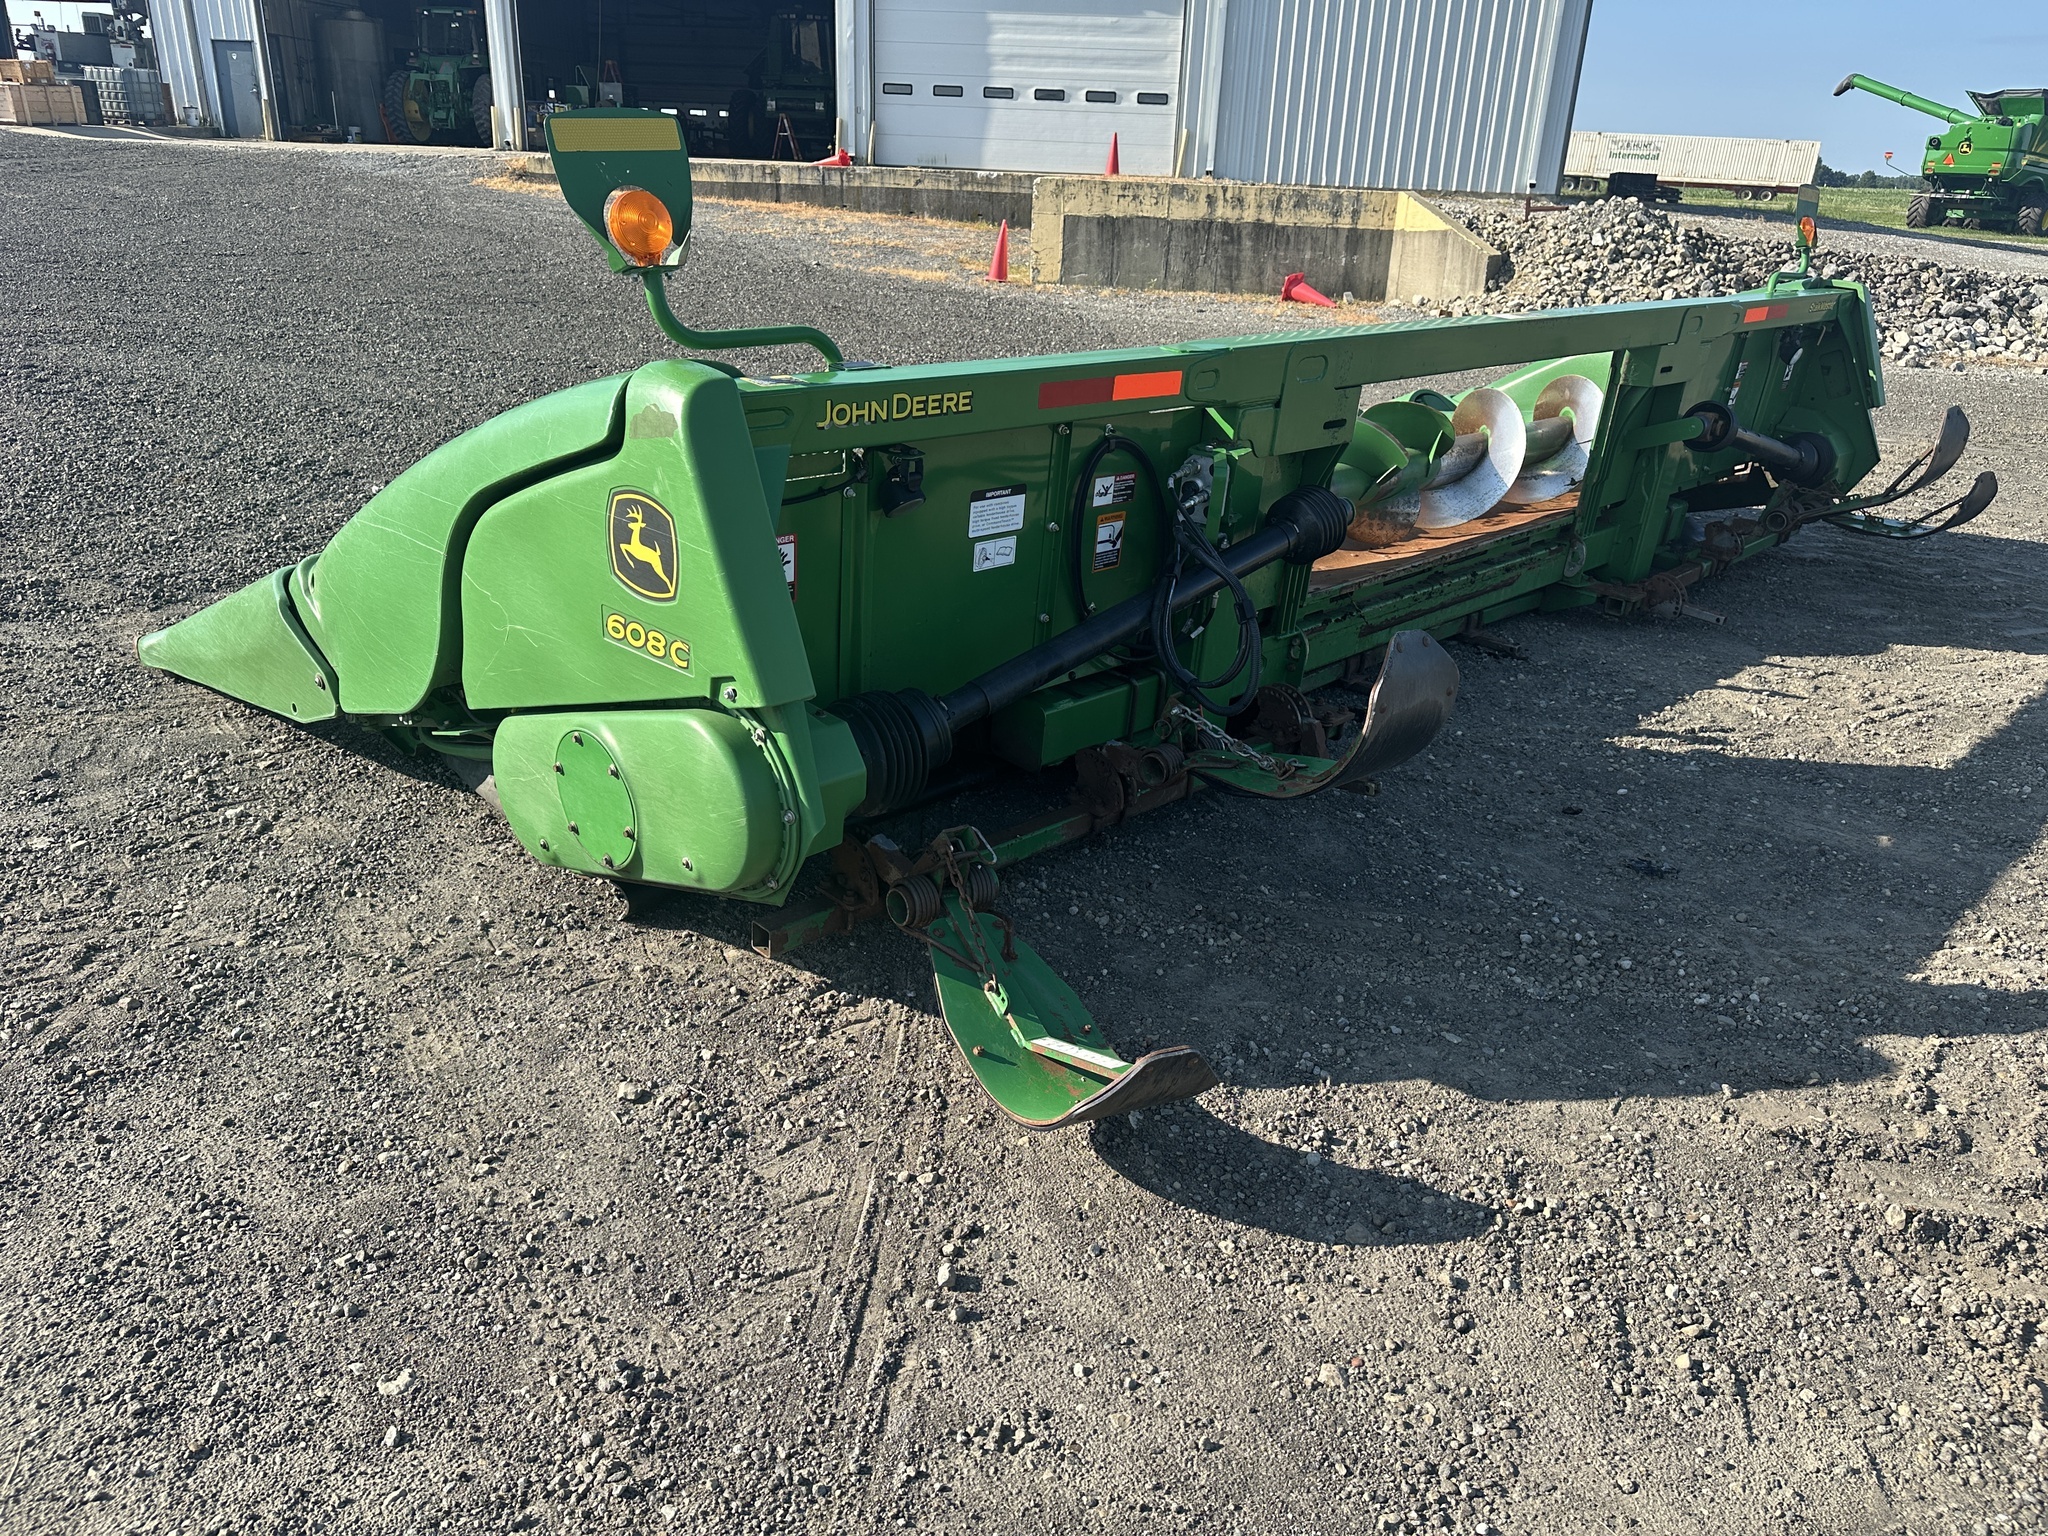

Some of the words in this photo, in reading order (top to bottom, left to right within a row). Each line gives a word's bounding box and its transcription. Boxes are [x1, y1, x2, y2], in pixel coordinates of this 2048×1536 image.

[1633, 142, 1653, 150] HUNT
[1609, 151, 1660, 160] Intermodal
[816, 399, 887, 428] JOHN
[891, 390, 973, 420] DEERE
[986, 488, 1012, 498] IMPORTANT
[1104, 513, 1123, 521] WARNING
[775, 535, 794, 544] NGER
[606, 613, 690, 669] 608C
